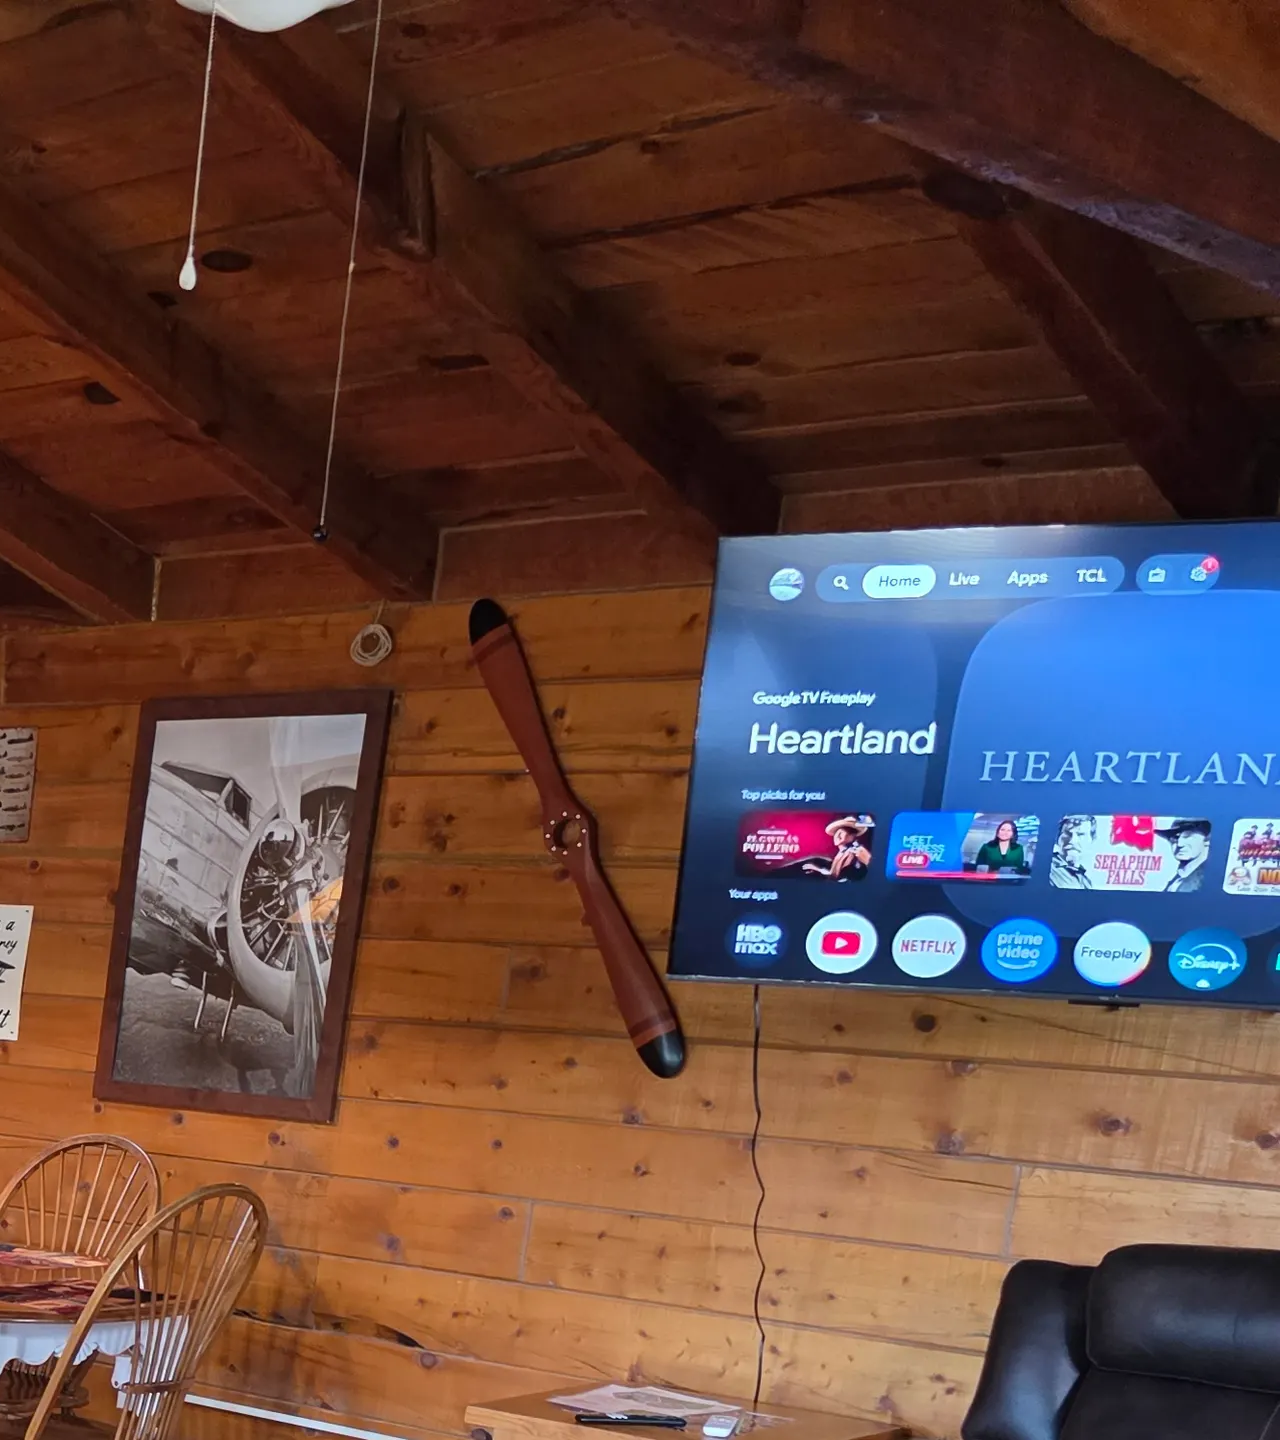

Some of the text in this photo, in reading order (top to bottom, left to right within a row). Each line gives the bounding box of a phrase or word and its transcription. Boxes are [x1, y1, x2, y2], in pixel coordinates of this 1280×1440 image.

[878, 568, 1107, 588] Home Live Apps TCL
[752, 690, 877, 707] Google TV Freeplay
[748, 721, 938, 755] Heartland
[979, 750, 1280, 785] HEARTLAN
[741, 789, 826, 802] Top picks for you
[903, 835, 933, 848] MEET
[902, 855, 925, 864] LIVE
[1094, 855, 1162, 871] SERAPHIM
[1106, 870, 1146, 885] FALLS
[728, 889, 778, 902] Your apps
[5, 920, 16, 931] a
[736, 924, 782, 942] HBO
[900, 939, 957, 955] NETFLIX
[997, 932, 1043, 947] prime
[734, 942, 777, 955] max
[997, 947, 1040, 959] video
[1081, 946, 1142, 962] Freeplay
[1175, 952, 1240, 974] Disney+
